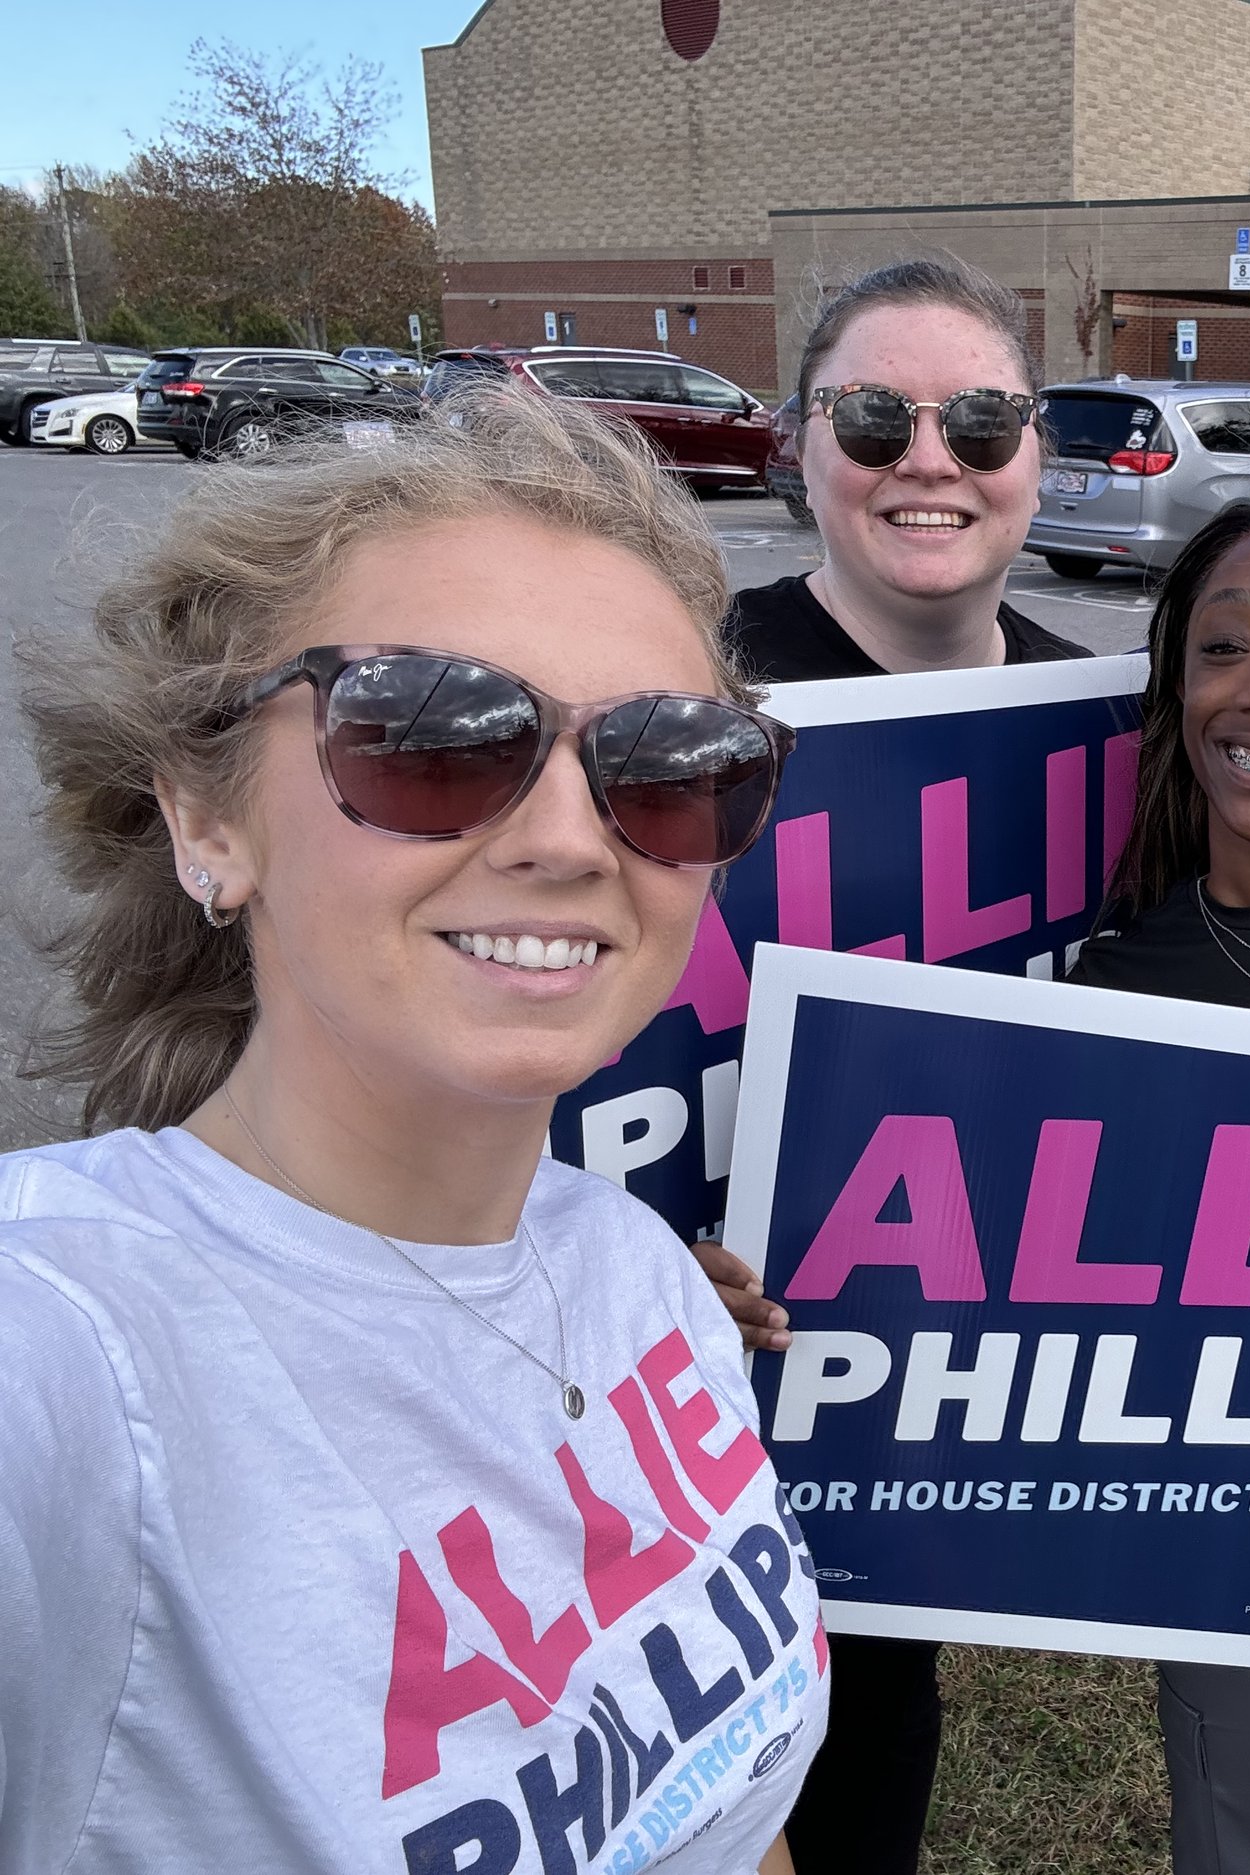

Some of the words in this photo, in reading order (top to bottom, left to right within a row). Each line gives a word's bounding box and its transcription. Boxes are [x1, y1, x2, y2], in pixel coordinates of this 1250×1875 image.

[1239, 265, 1246, 277] 8
[779, 1481, 857, 1511] OR
[870, 1481, 1037, 1511] HOUSE
[382, 1327, 768, 1800] ALLIE
[639, 1695, 768, 1850] DISTRICT
[772, 1655, 808, 1714] 75
